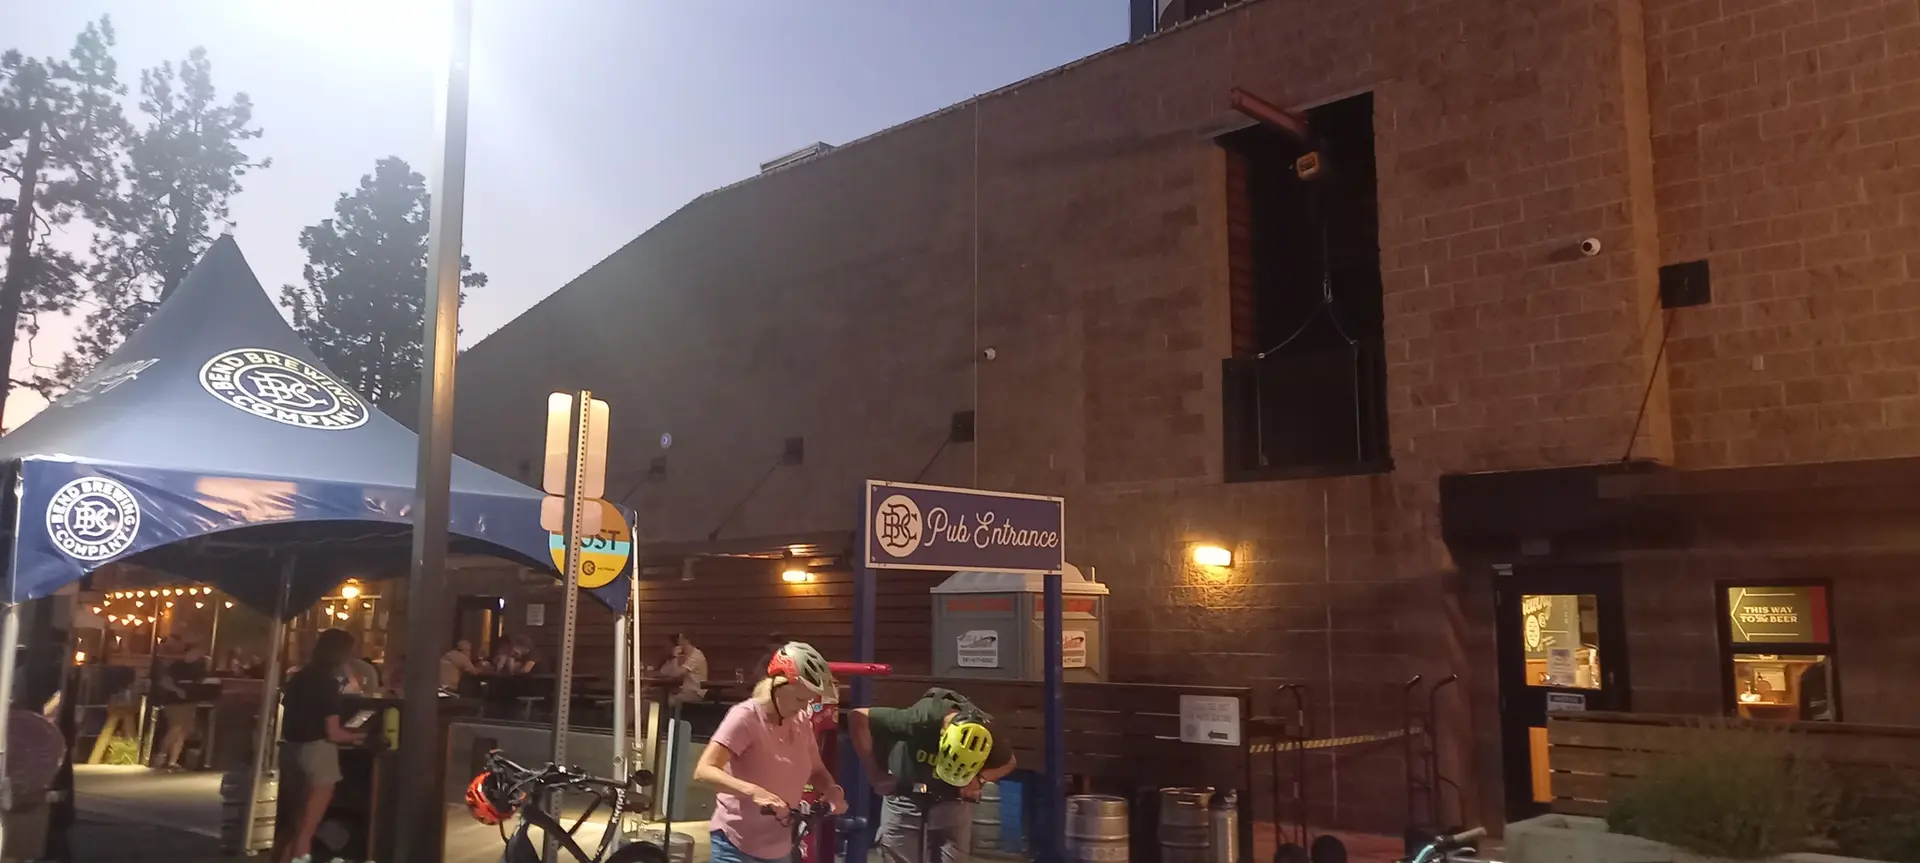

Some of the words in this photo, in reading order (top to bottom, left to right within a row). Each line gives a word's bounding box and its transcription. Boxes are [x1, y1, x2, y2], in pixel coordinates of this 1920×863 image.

[208, 356, 245, 391] BEND
[243, 352, 358, 407] BREWING
[232, 395, 360, 427] COMPANY
[51, 486, 80, 524] BEND
[81, 480, 136, 526] BREWING
[56, 529, 129, 557] COMPANY
[923, 507, 971, 547] Pub
[973, 511, 1059, 549] Entrance
[1740, 615, 1755, 623] TO
[1770, 615, 1798, 623] BEER
[1743, 606, 1769, 614] THIS
[1770, 606, 1793, 614] WAY
